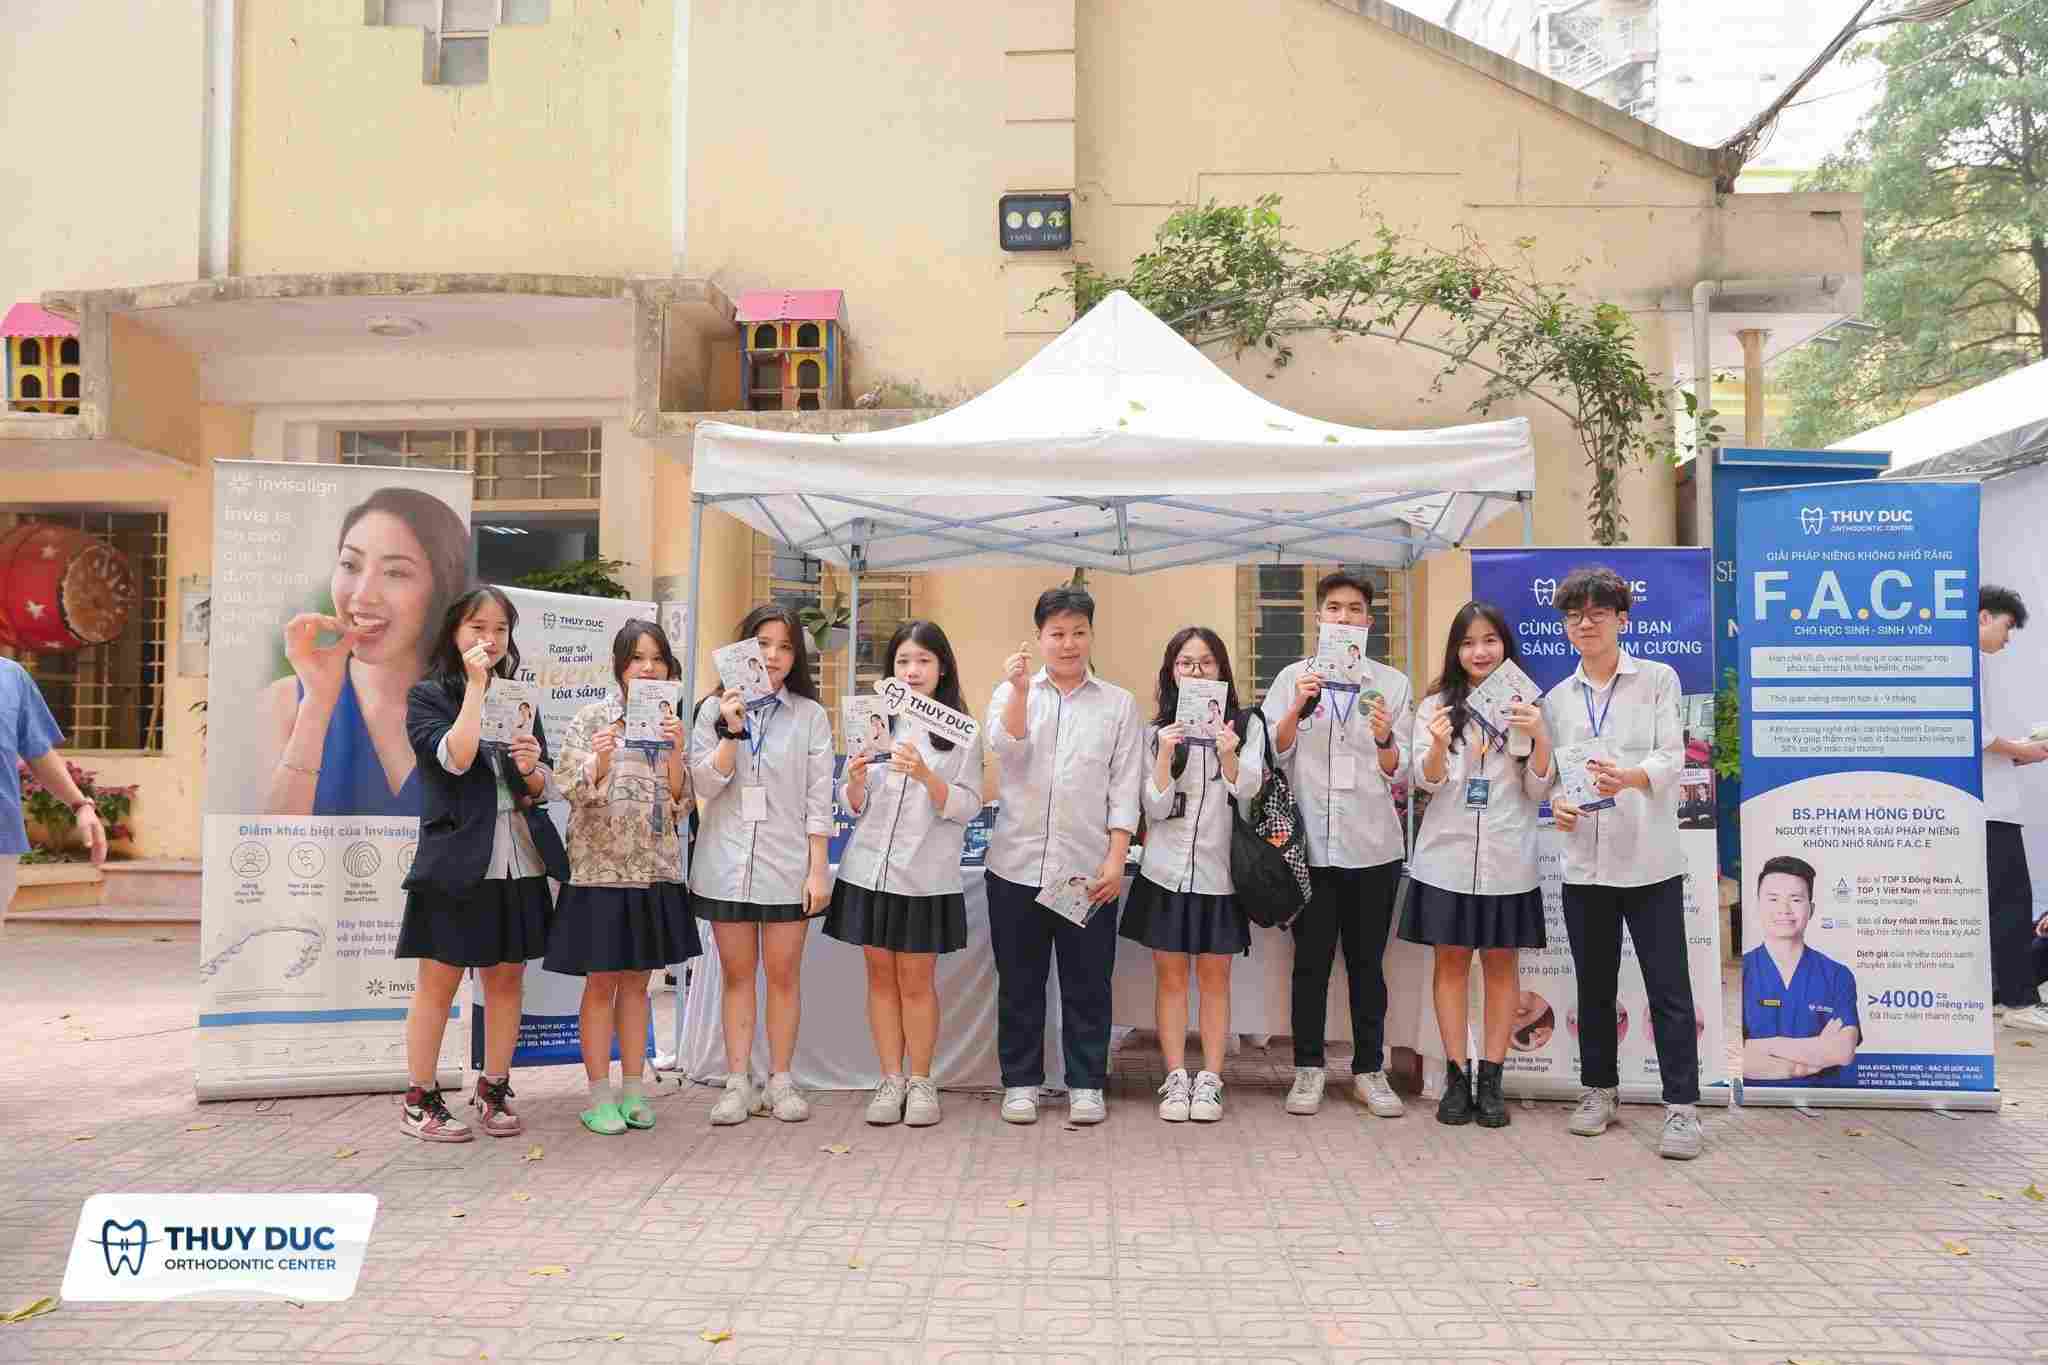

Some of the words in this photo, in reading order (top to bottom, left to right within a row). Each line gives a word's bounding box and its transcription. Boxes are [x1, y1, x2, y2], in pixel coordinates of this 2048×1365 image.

[257, 475, 337, 497] invisalign
[1830, 510, 1874, 522] THUY
[1878, 510, 1913, 522] DUC
[1858, 548, 1896, 561] KHÔNG
[1754, 569, 1968, 620] F.A.C.E
[559, 616, 583, 625] THUY
[585, 618, 604, 628] DUC
[1519, 619, 1563, 636] CÙNG
[1638, 621, 1672, 638] BẠN
[1794, 625, 1817, 636] CHO
[1845, 625, 1871, 636] SINH
[1878, 625, 1904, 636] SINH
[1907, 623, 1933, 636] VIÊN
[1522, 640, 1566, 656] SÁNG
[1644, 640, 1703, 655] CƯƠNG
[909, 696, 945, 720] THUY
[944, 714, 975, 734] DUC
[1792, 808, 1861, 823] BS.PHẠM
[1911, 805, 1946, 820] ĐỨC
[1858, 826, 1872, 836] RA
[1857, 887, 1873, 895] TOP
[1901, 887, 1920, 895] Nam
